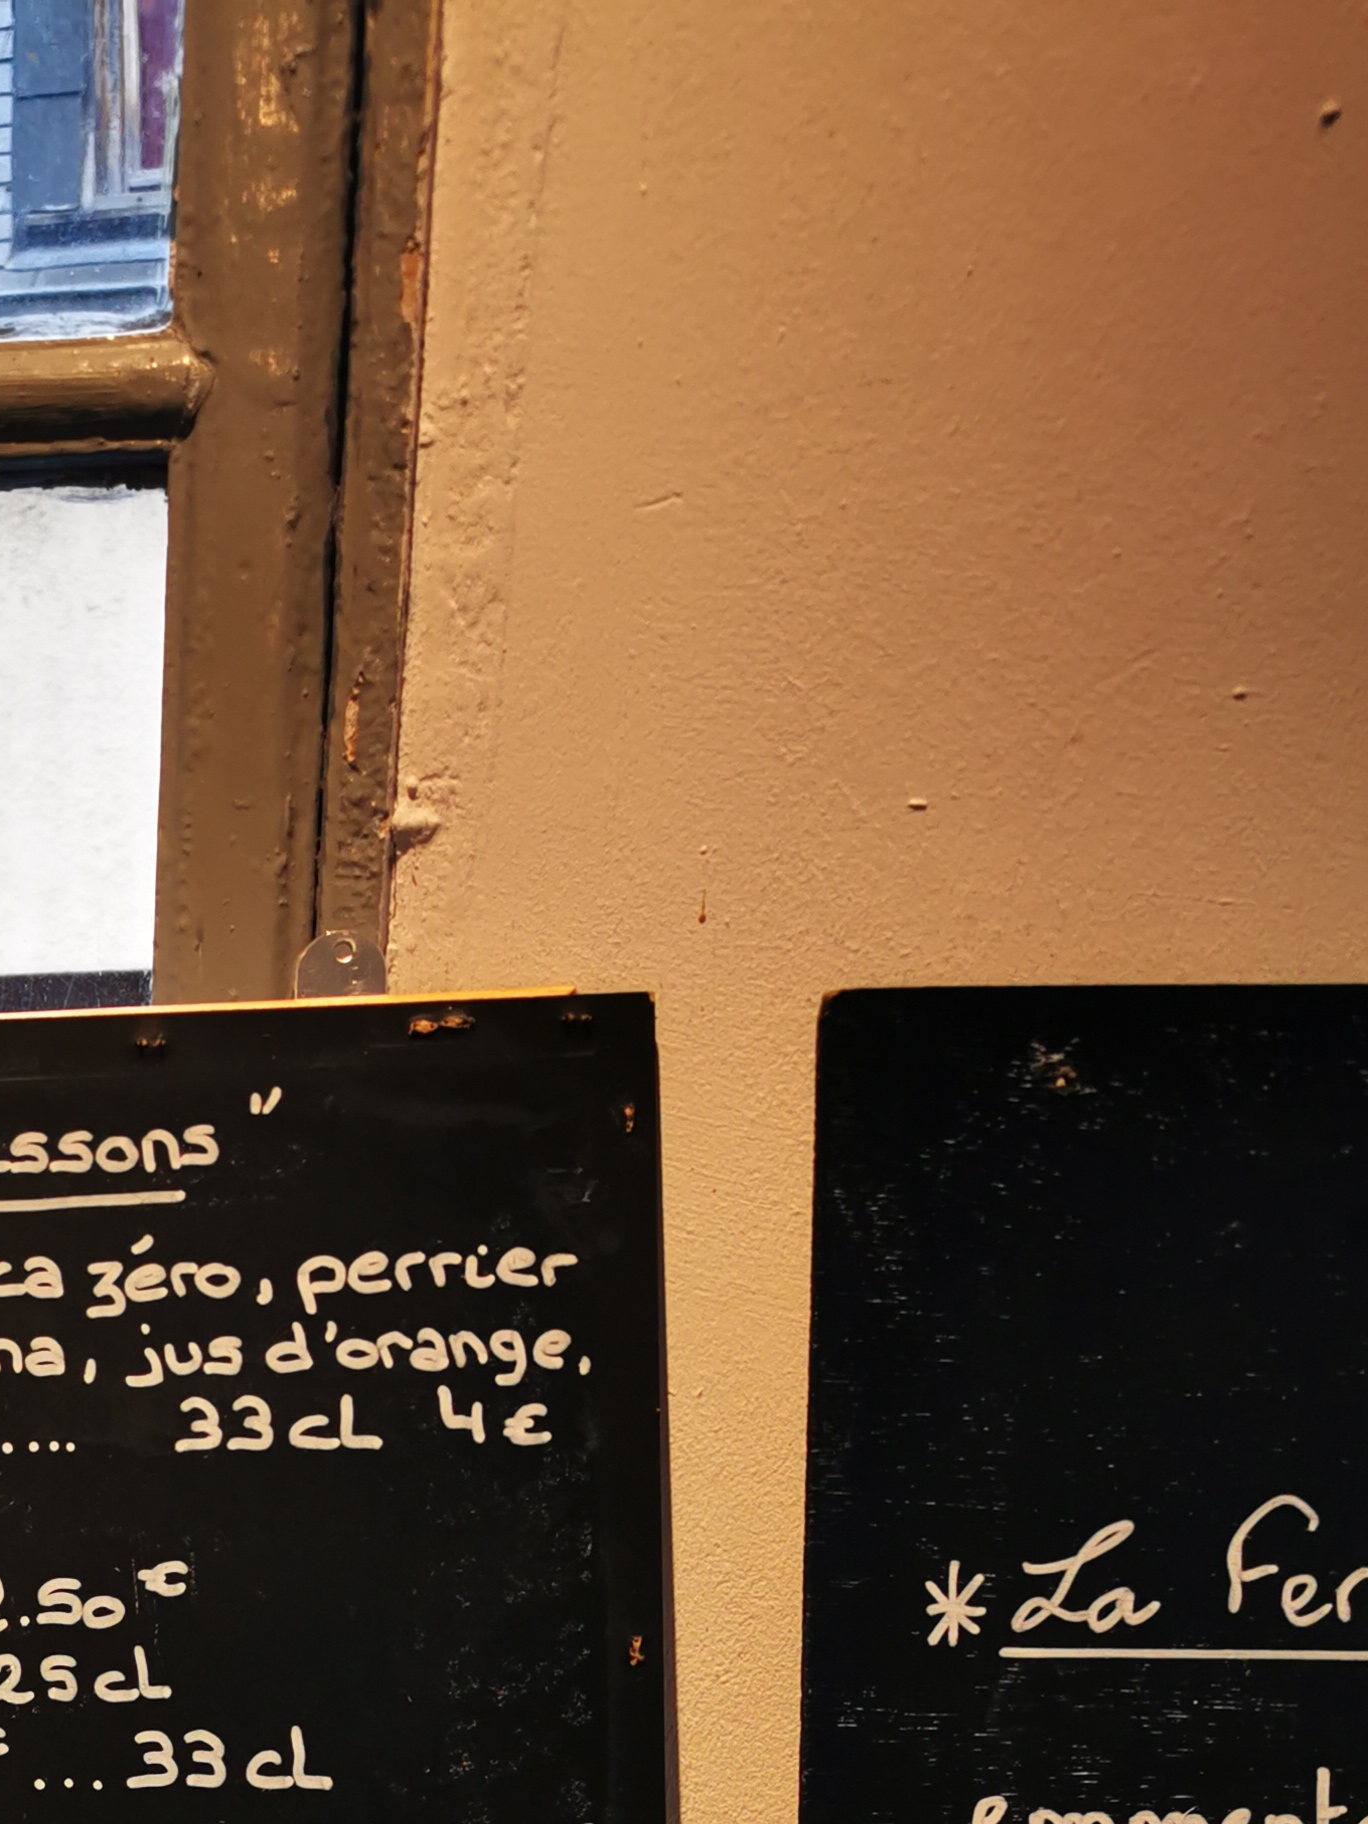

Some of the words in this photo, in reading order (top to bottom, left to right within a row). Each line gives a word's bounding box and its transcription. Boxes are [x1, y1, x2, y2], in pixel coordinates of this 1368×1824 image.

[297, 1245, 578, 1314] perrier
[125, 1324, 242, 1387] jus
[1011, 1520, 1160, 1633] La
